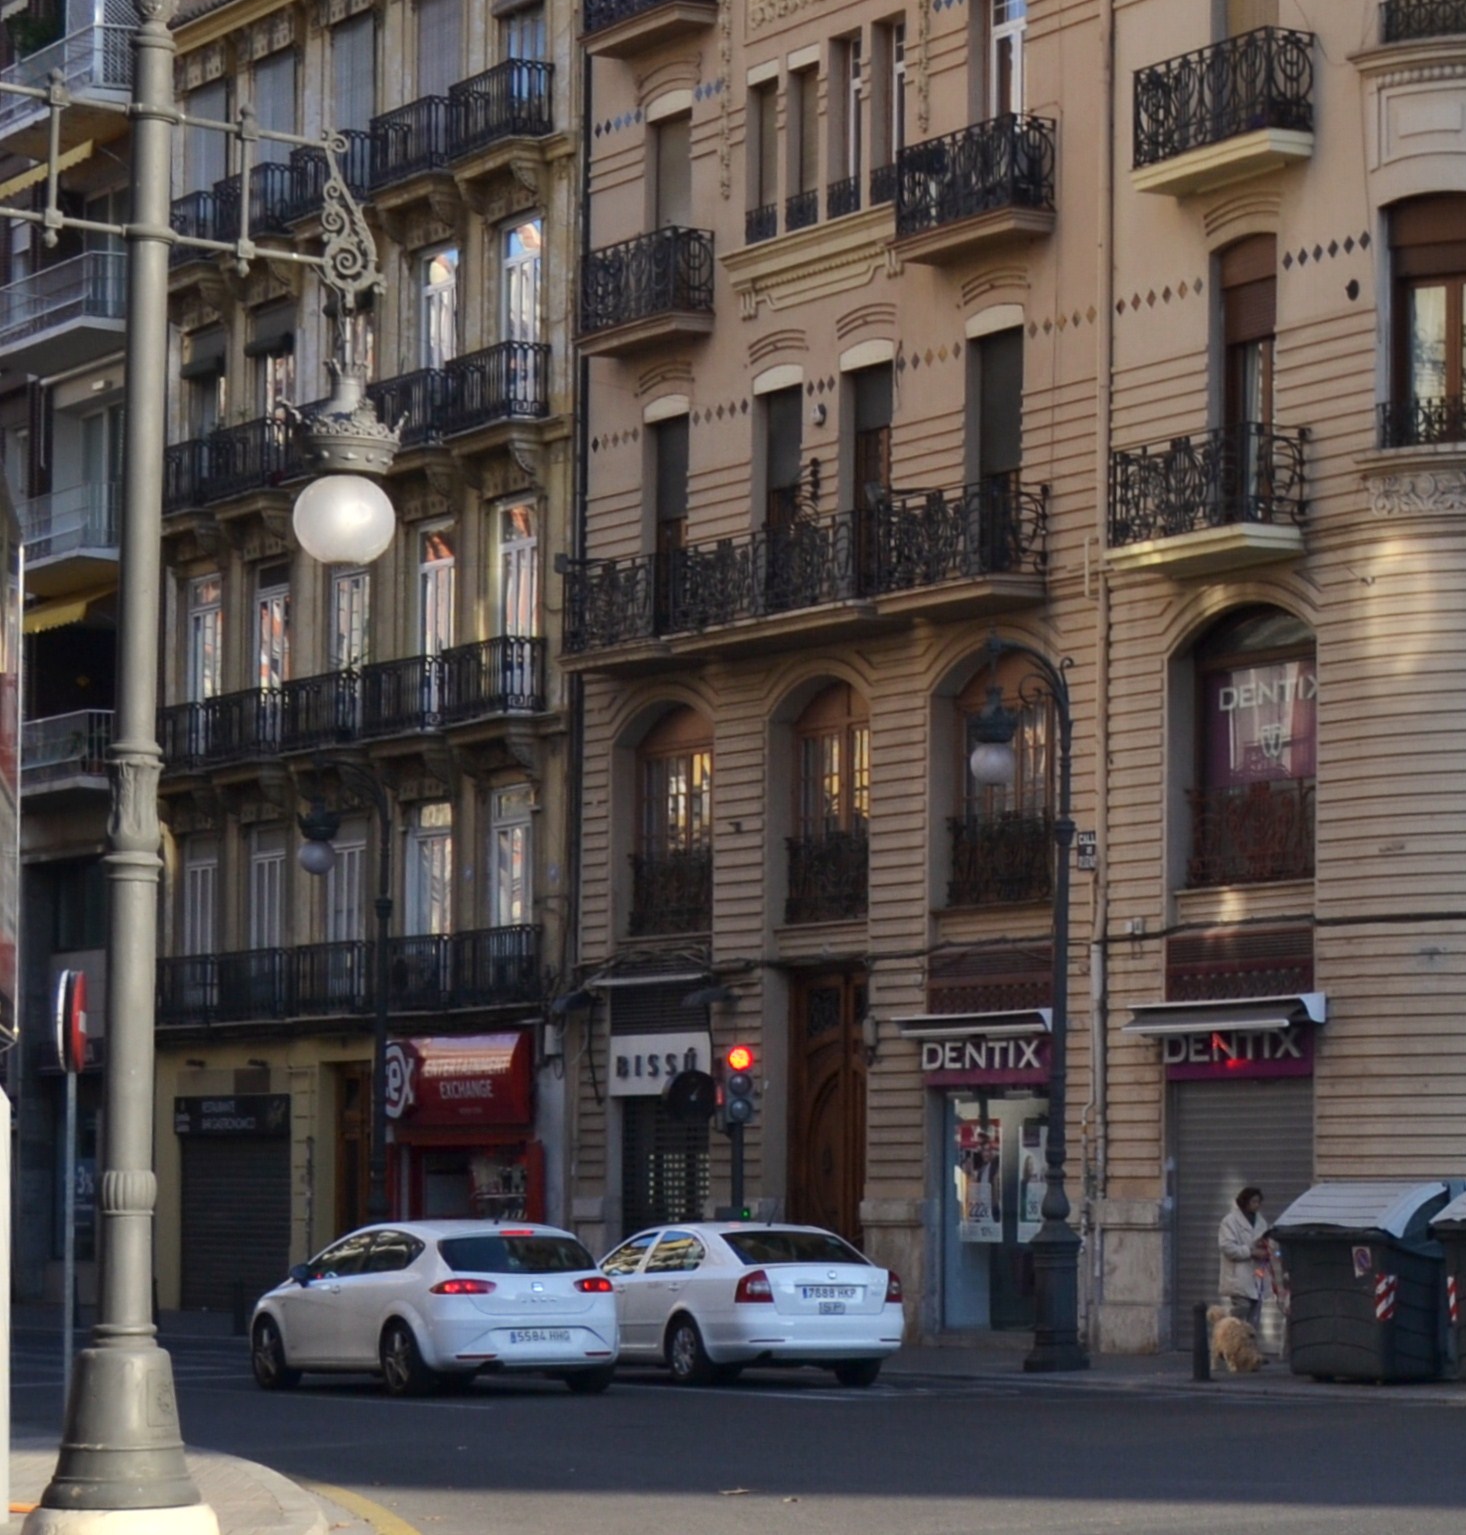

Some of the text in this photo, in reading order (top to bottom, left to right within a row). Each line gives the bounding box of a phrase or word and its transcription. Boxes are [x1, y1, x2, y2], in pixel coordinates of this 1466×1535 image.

[921, 1040, 1041, 1070] DENTIX
[1163, 1028, 1302, 1064] DENTIX
[440, 1080, 494, 1099] EXCHANGE
